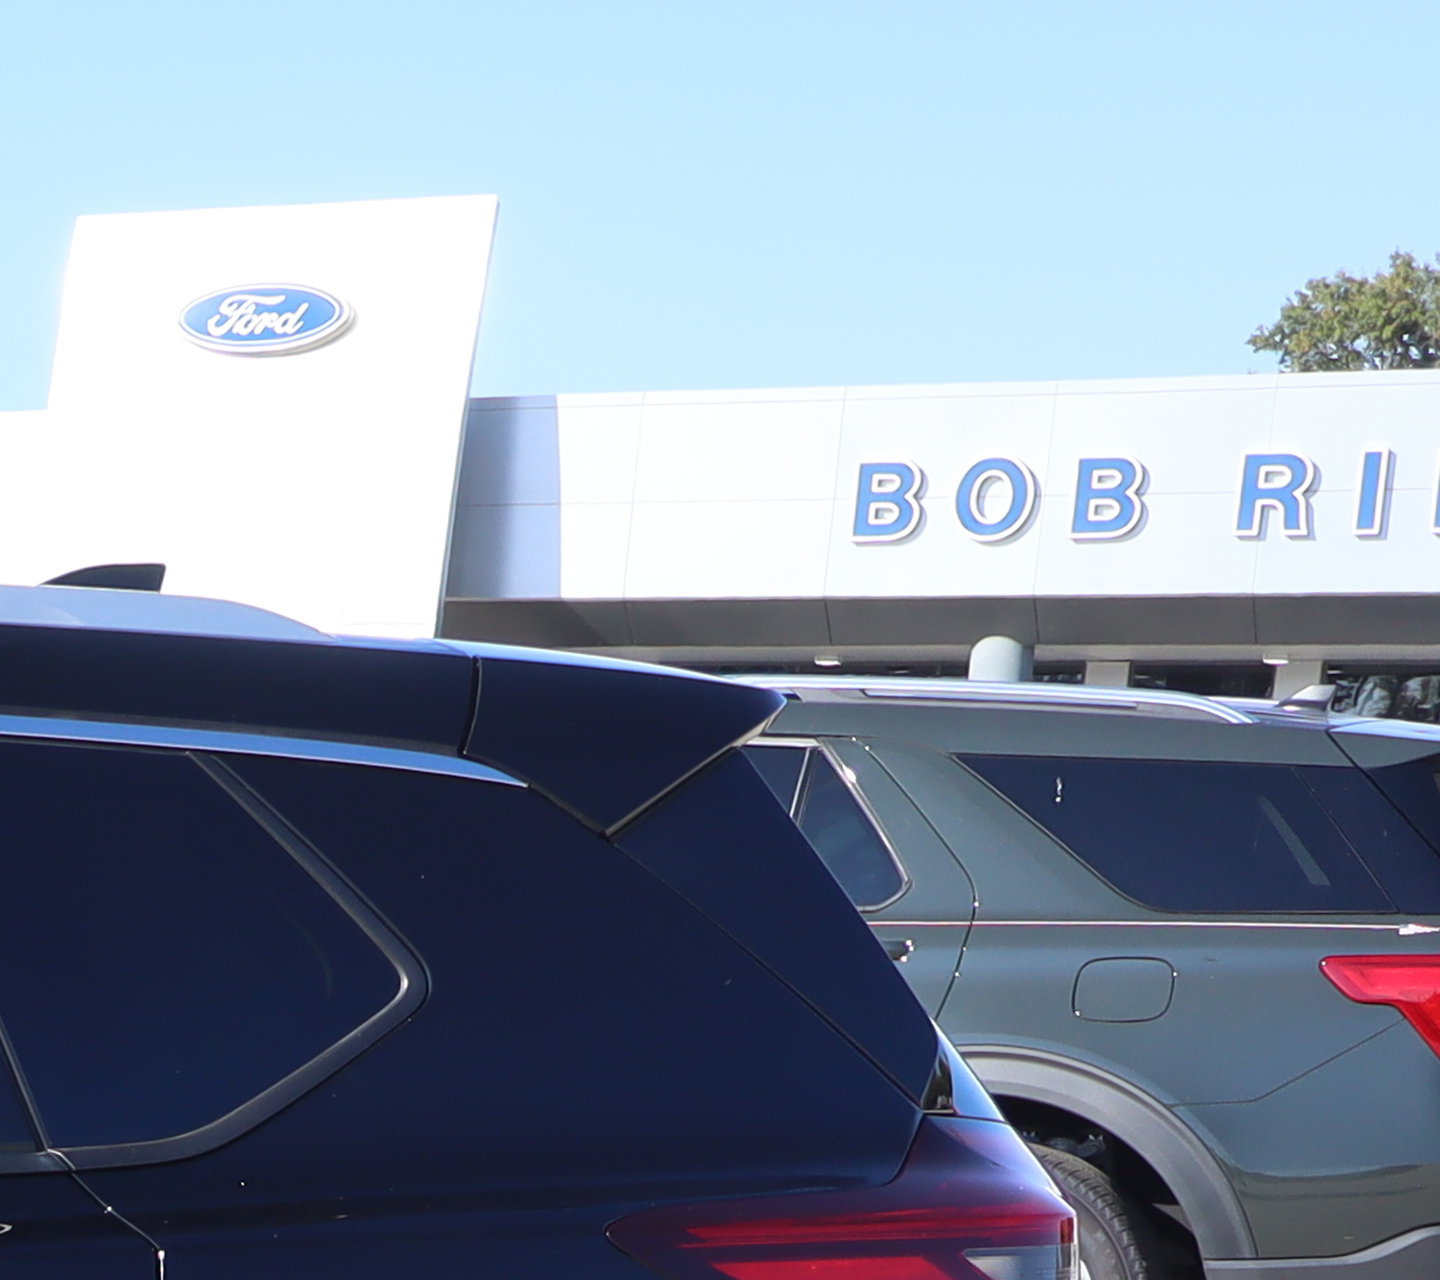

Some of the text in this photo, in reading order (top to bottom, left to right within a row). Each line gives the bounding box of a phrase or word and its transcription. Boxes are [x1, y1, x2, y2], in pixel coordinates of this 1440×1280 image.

[206, 293, 310, 337] Ford
[852, 447, 1440, 545] BOB RI
